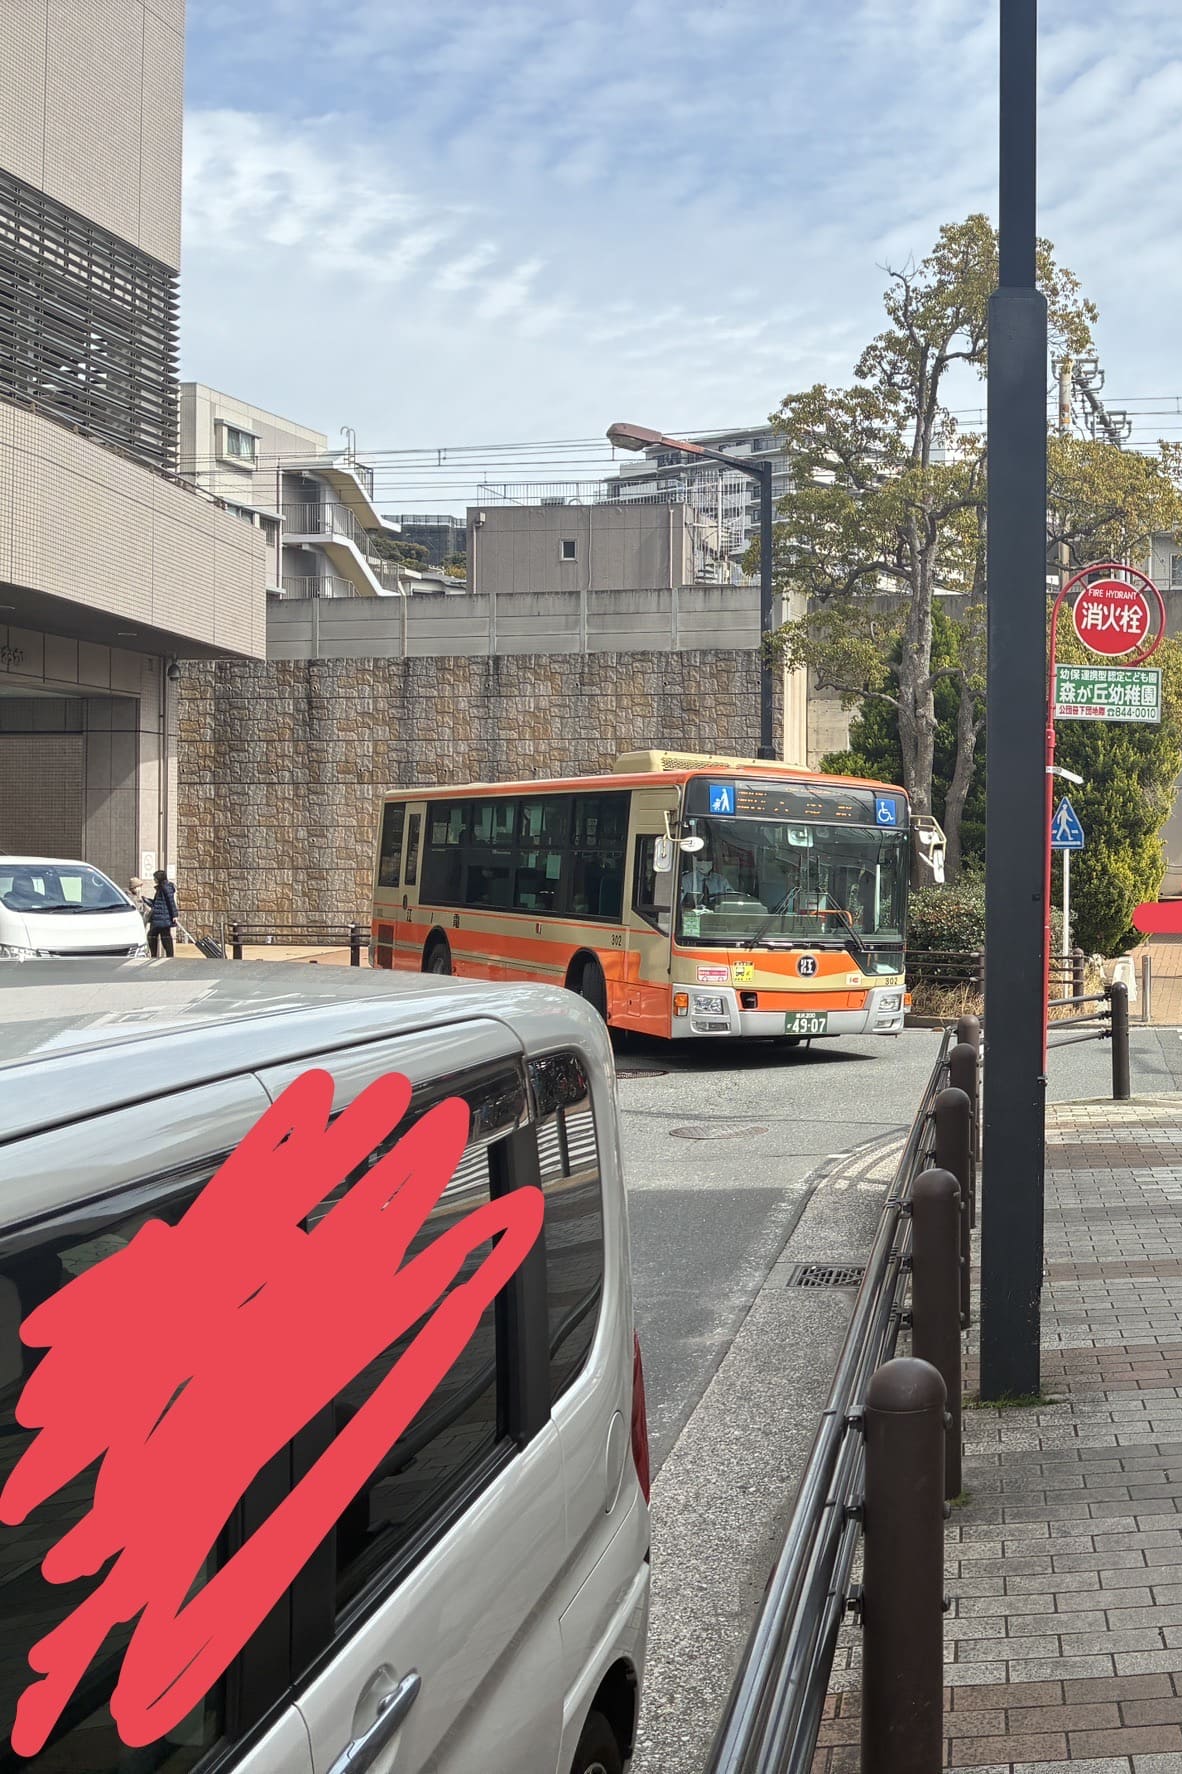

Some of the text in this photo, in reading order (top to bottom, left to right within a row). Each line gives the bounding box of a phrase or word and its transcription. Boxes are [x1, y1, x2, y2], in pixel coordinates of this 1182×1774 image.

[1088, 588, 1137, 601] FIRE HYDRANT
[1081, 601, 1143, 634] 消火栓
[1059, 681, 1157, 706] 森が丘幼稚園
[611, 934, 622, 946] 302
[885, 976, 898, 985] 302
